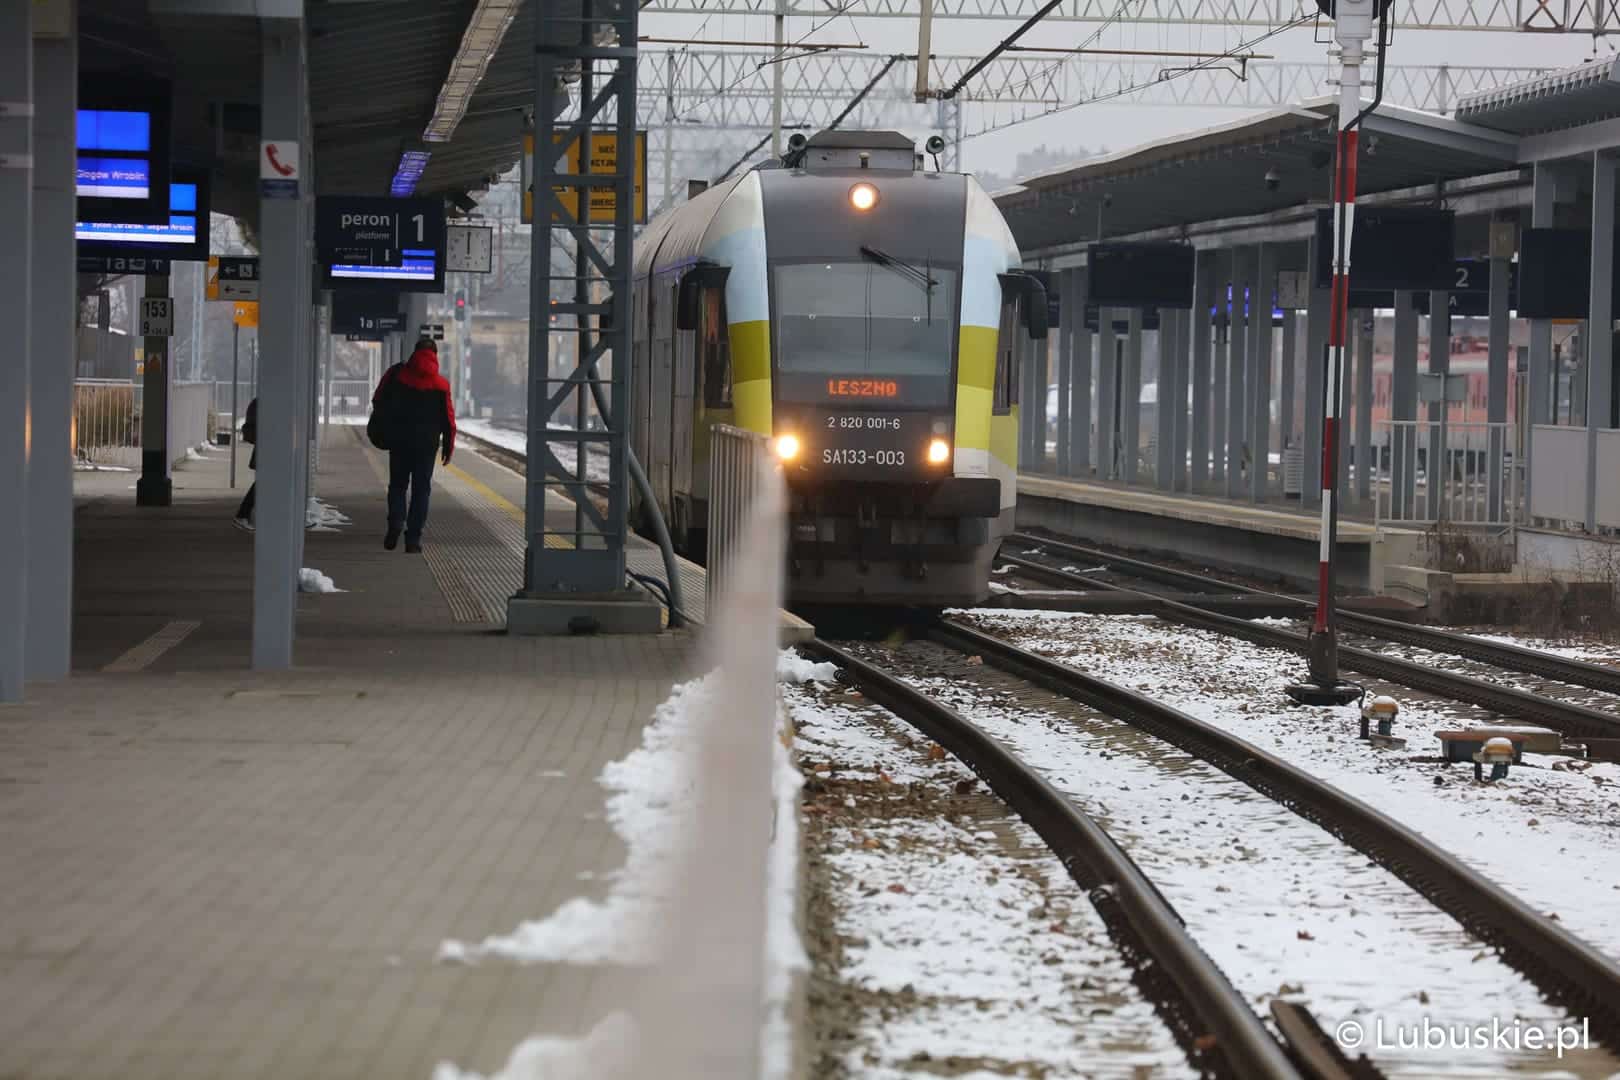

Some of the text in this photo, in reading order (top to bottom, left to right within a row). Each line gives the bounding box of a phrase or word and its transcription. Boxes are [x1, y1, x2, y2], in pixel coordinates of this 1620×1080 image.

[341, 213, 424, 242] peron 1
[355, 231, 390, 241] platform
[1455, 267, 1469, 288] 2
[144, 301, 167, 318] 153
[360, 316, 374, 329] 1a
[828, 379, 897, 396] LESZNO
[827, 416, 901, 430] 2 820 001-6
[823, 448, 905, 466] SA133-003
